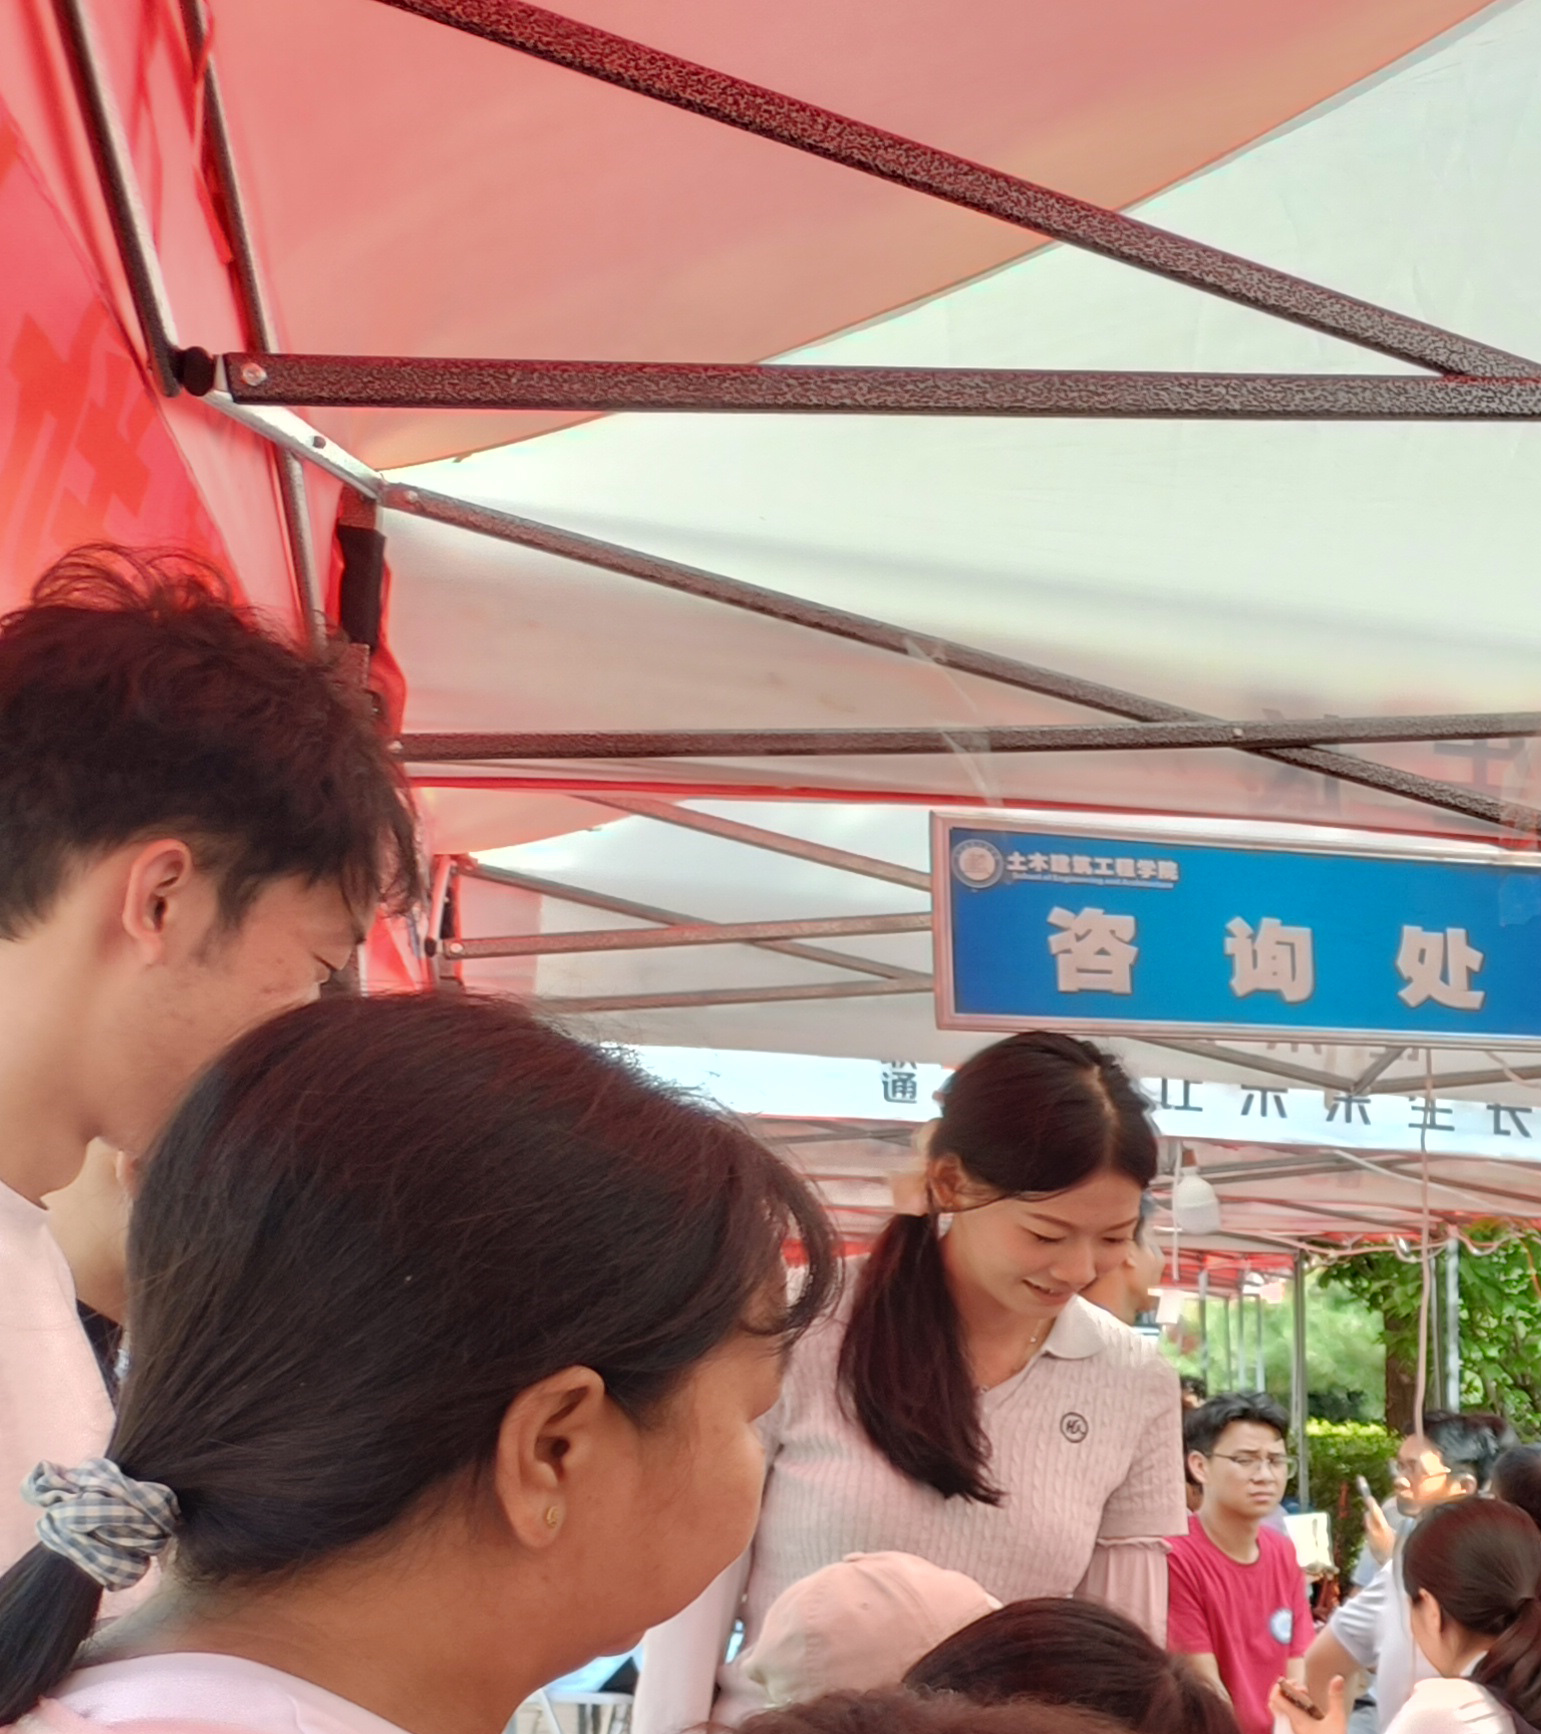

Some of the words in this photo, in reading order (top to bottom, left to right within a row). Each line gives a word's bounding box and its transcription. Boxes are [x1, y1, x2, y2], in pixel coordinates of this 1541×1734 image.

[1006, 851, 1180, 882] 土木建筑工程学院
[1047, 907, 1485, 1011] 咨询处
